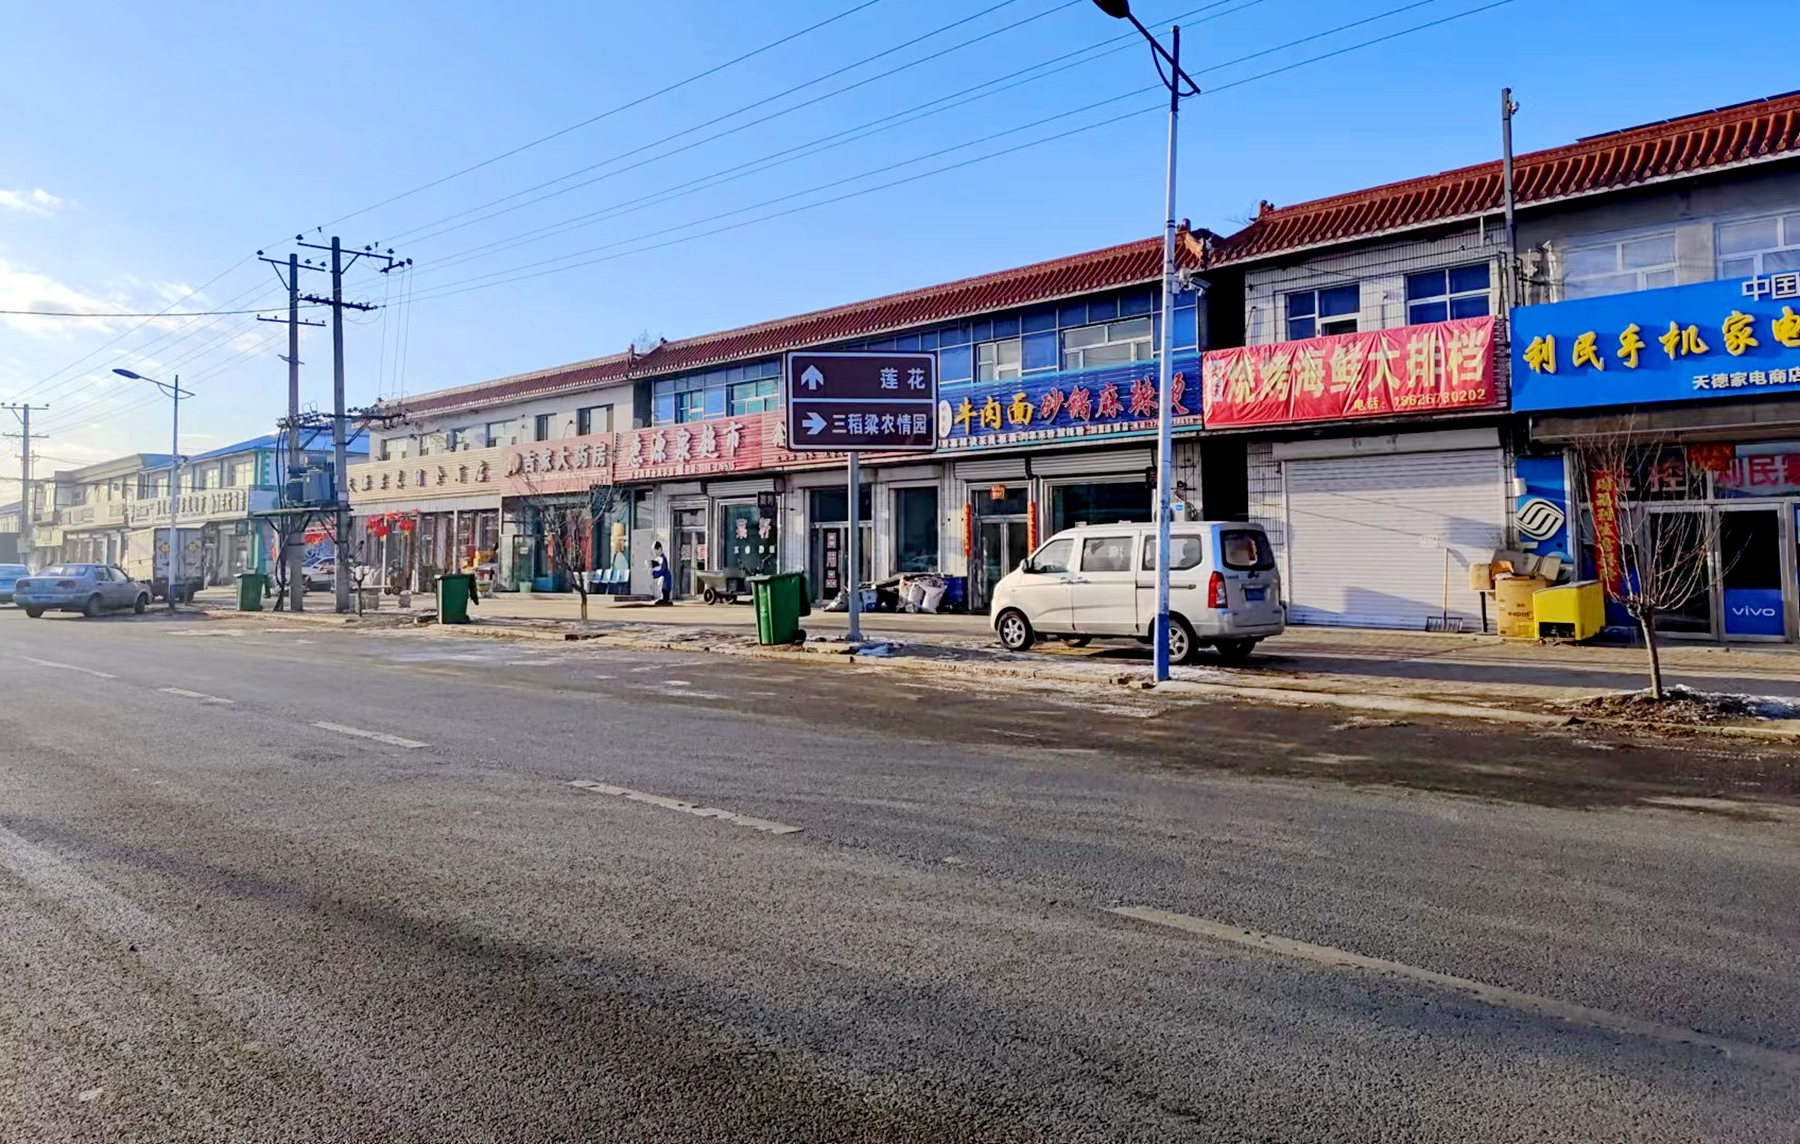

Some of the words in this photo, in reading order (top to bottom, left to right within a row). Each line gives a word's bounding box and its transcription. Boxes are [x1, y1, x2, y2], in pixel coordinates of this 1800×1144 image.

[1523, 305, 1800, 375] 利民手机家电
[880, 367, 926, 390] 莲花
[1226, 326, 1486, 406] 烧烤海鲜大排档
[1692, 365, 1800, 391] 天德家电商店
[953, 392, 1035, 435] 牛肉面
[1732, 605, 1776, 616] vivo
